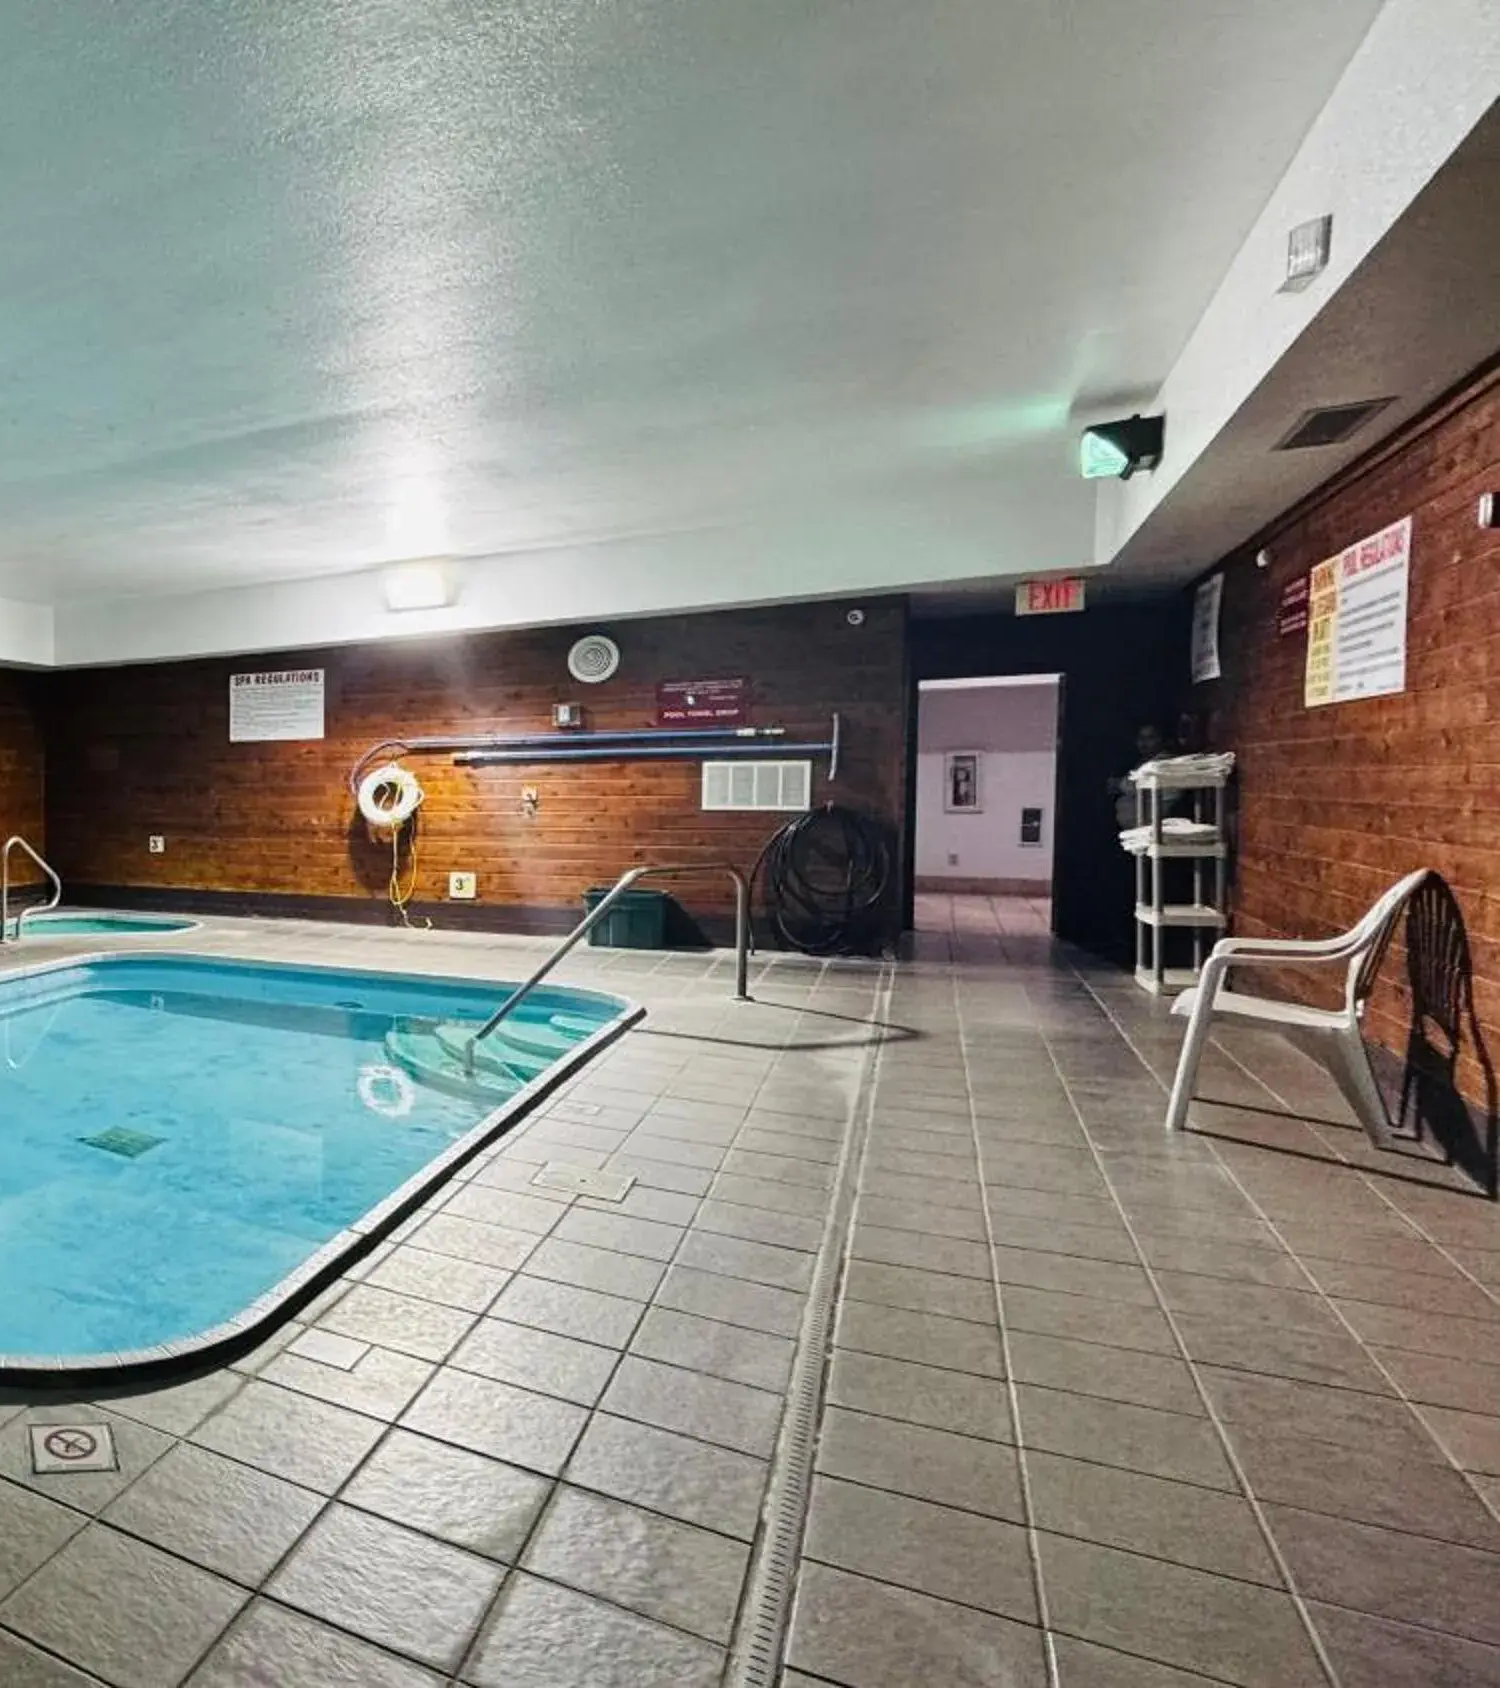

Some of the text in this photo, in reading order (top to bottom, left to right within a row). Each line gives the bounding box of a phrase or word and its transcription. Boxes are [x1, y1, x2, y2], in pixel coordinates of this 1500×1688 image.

[1028, 581, 1076, 611] EXIT
[235, 671, 320, 686] SPA REGULATIONS
